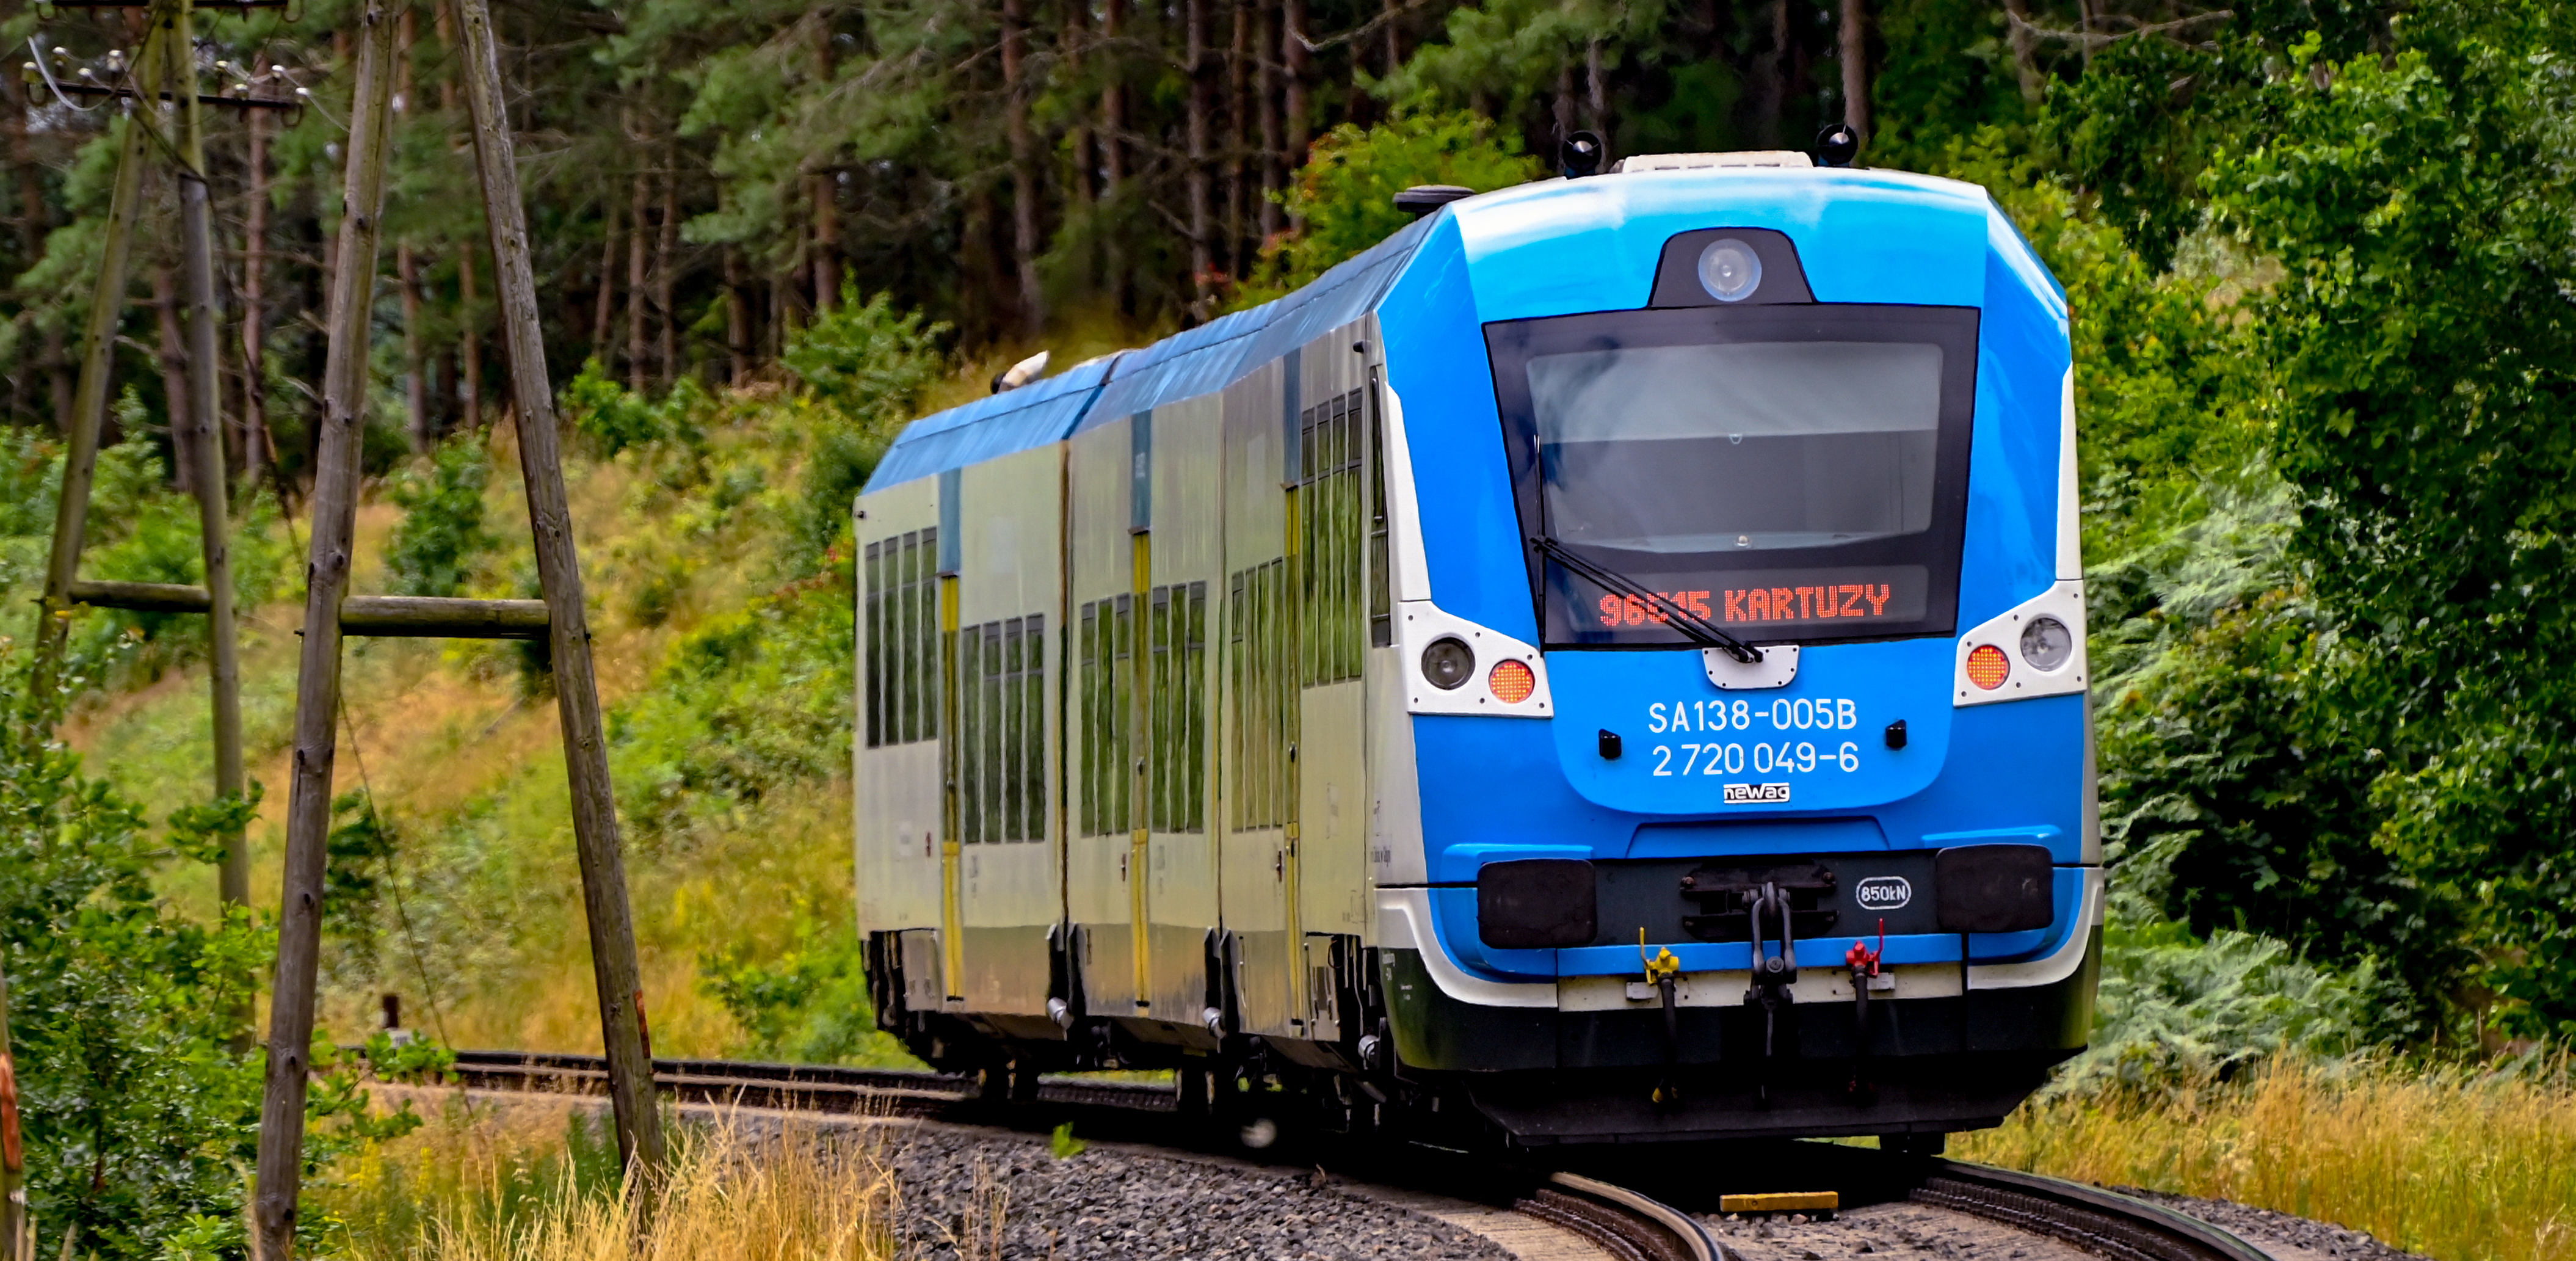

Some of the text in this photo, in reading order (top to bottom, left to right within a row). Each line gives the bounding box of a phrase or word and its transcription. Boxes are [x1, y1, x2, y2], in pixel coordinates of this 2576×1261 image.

[1724, 584, 1890, 622] KARTUZY
[1649, 698, 1857, 733] SA138-005B
[1652, 741, 1859, 776] 2 720 049-6
[1861, 885, 1906, 902] 850kN
